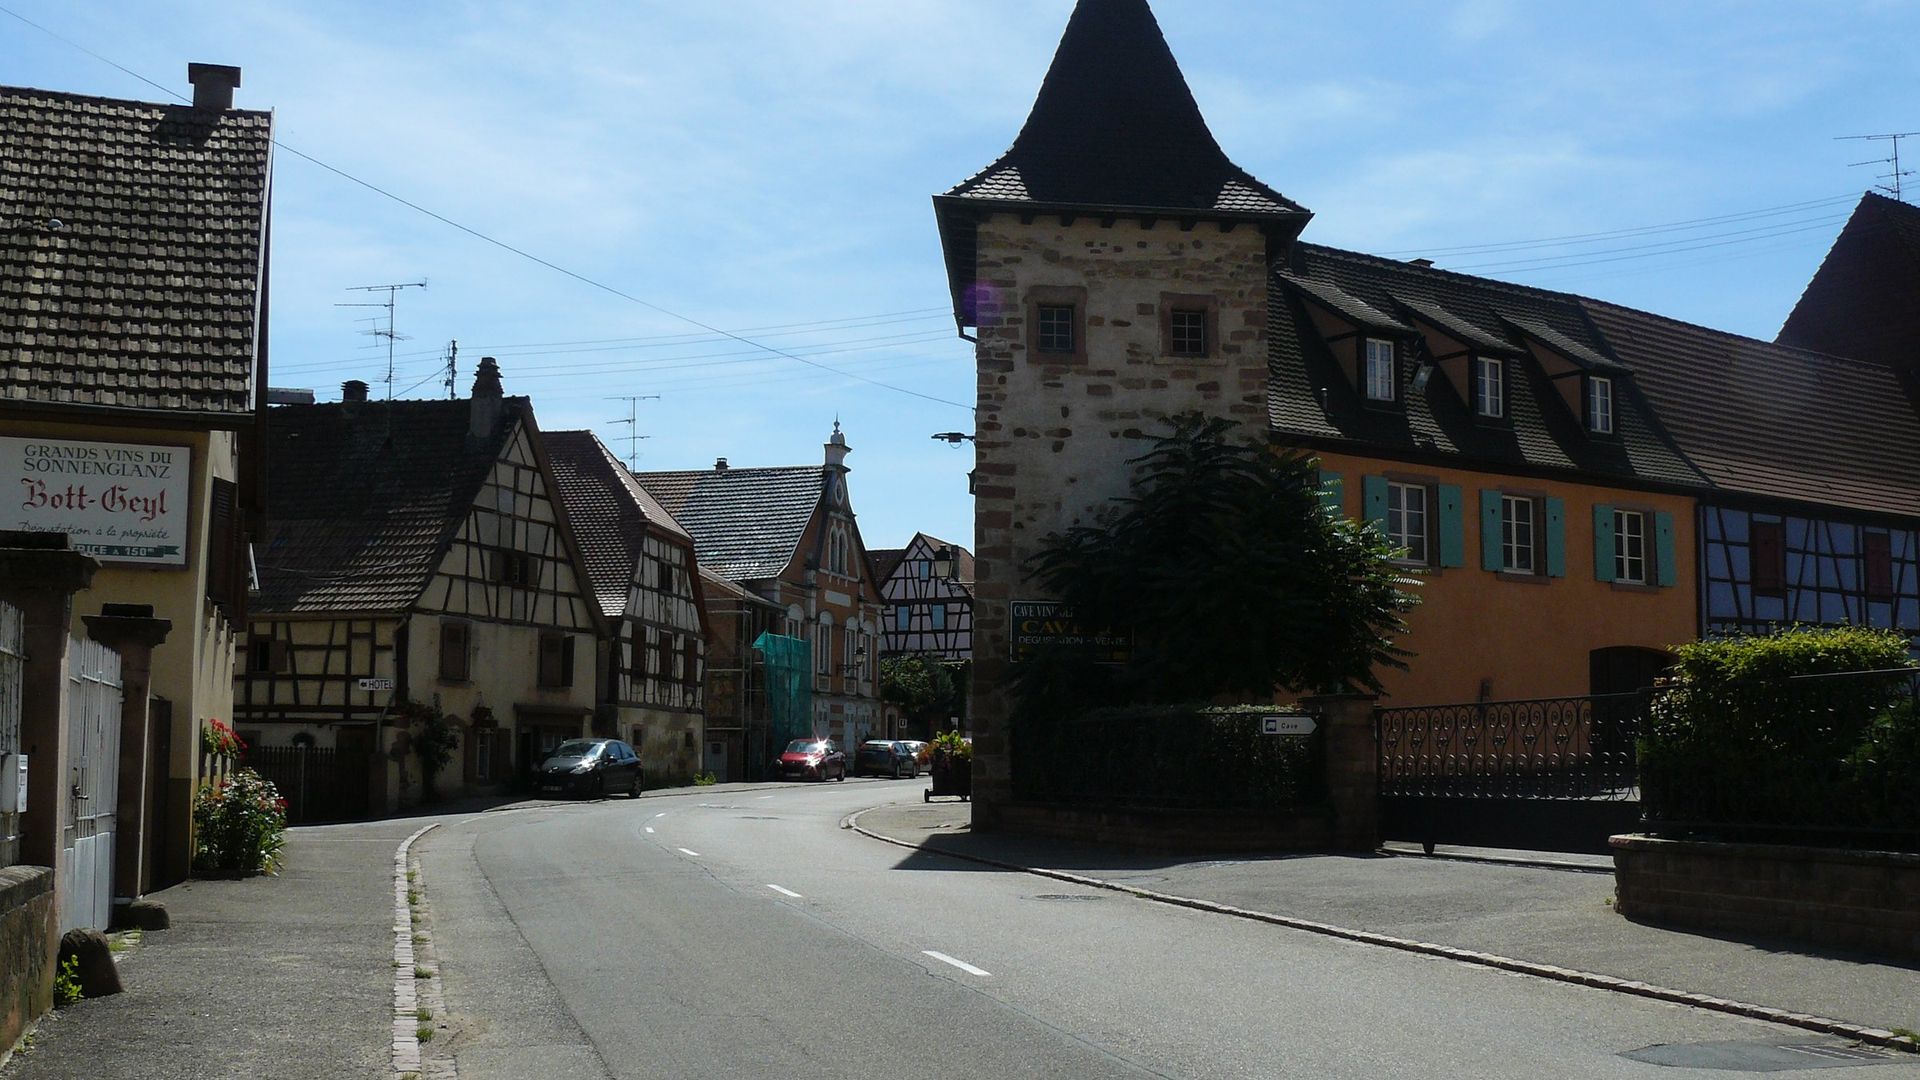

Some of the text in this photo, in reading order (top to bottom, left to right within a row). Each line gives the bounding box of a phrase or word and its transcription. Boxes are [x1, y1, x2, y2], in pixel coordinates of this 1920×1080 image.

[24, 444, 172, 464] GRANDS VINS DU
[24, 458, 170, 479] SONNENGLANZ
[21, 477, 168, 523] Bott-Geyl
[106, 525, 118, 537] la
[1014, 605, 1035, 618] CAVE
[369, 680, 393, 690] HOTEL
